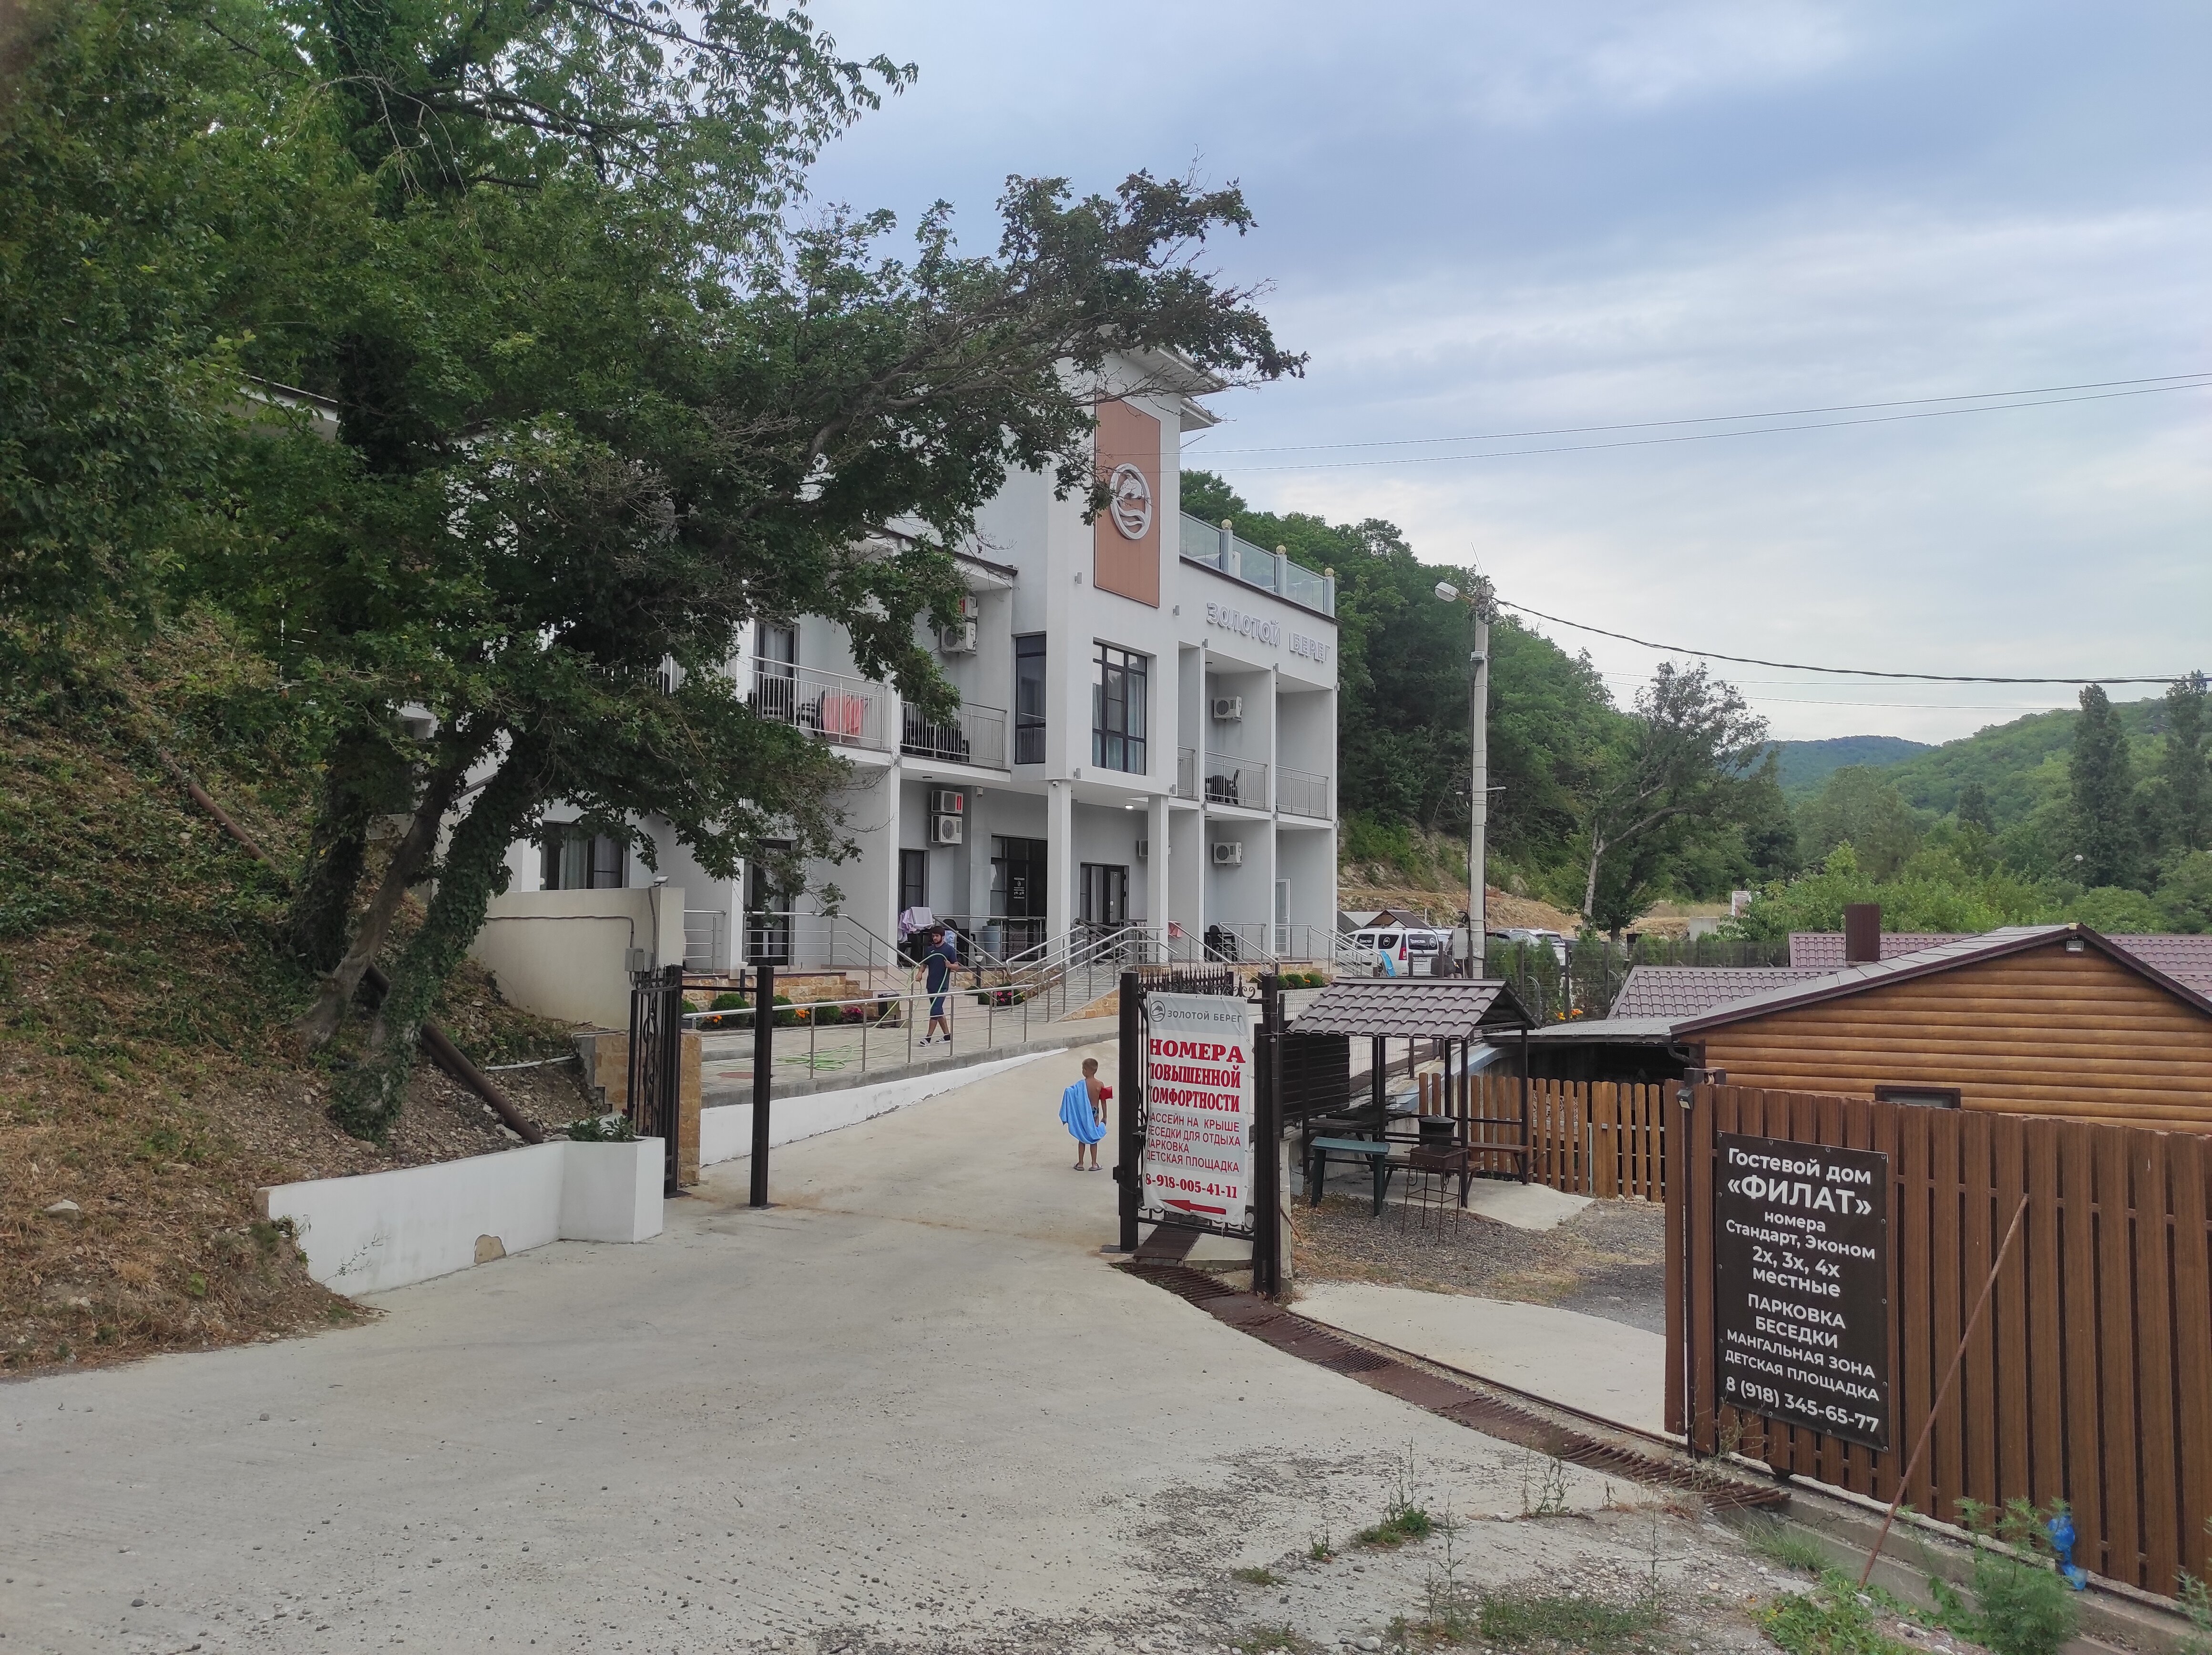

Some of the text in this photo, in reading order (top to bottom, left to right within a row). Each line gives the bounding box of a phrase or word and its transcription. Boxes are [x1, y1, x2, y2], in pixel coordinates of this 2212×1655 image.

[1207, 602, 1331, 663] ЗОЛОТОЙ БЕРЕГ
[1167, 1010, 1243, 1023] ЗОЛОТОЙ БЕРЕГ
[1150, 1038, 1246, 1063] НОМЕРА
[1149, 1112, 1239, 1133] АССЕЙН НА КРЫШЕ
[1183, 1130, 1200, 1143] ДЛЯ
[1202, 1132, 1241, 1147] ОТДЫХА
[1147, 1150, 1239, 1174] ДЕТСКАЯ ПЛОЩАДКА
[1728, 1147, 1871, 1185] Гостевой дом
[1145, 1173, 1237, 1199] 8-918-005-41-11
[1727, 1174, 1872, 1215] «ФИЛАТ»
[1764, 1211, 1826, 1233] номера
[1726, 1219, 1875, 1259] Стандарт, Эконом
[1752, 1267, 1841, 1297] местные
[1815, 1259, 1841, 1278] 4х
[1748, 1293, 1846, 1329] ПАРКОВКА
[1755, 1316, 1838, 1349] БЕСЕДКИ
[1727, 1328, 1876, 1379] МАНГАЛЬНАЯ ЗОНА
[1725, 1349, 1880, 1401] ДЕТСКАЯ ПЛОЩАДКА
[1726, 1376, 1879, 1432] 8 (918) 345-65-77
